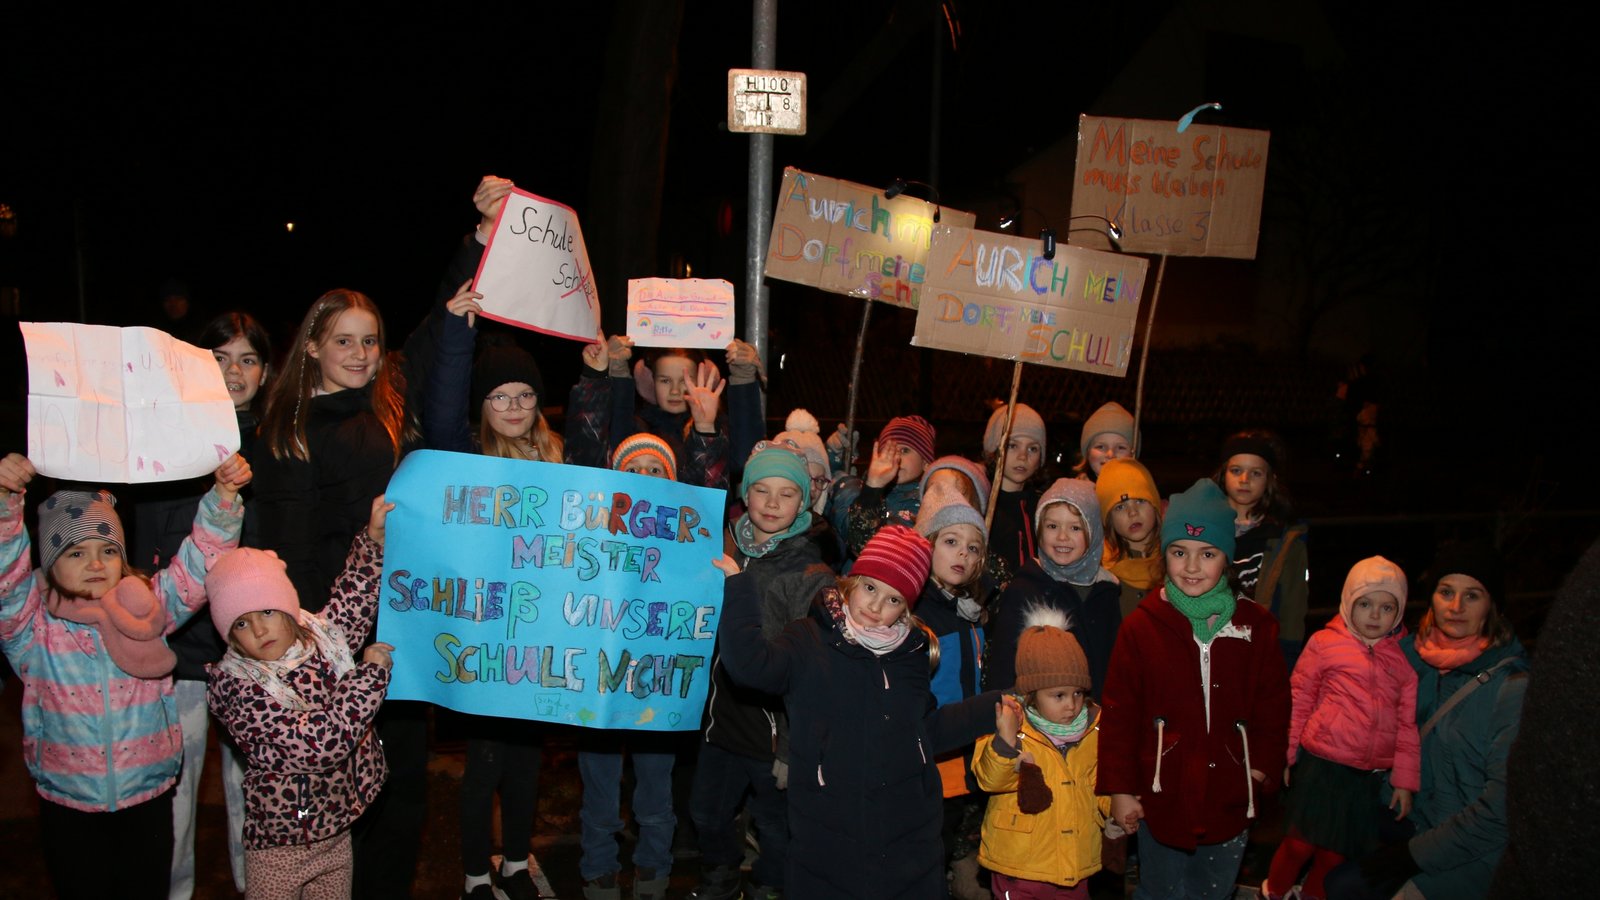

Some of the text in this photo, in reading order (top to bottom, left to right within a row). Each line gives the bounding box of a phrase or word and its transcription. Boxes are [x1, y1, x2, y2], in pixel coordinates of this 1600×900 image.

[783, 97, 791, 111] 8
[1089, 120, 1181, 168] Meine
[1083, 168, 1141, 195] muss
[510, 206, 574, 253] Schule
[1190, 210, 1211, 241] 3
[855, 250, 926, 284] meine
[1083, 269, 1139, 304] MEIN
[441, 484, 548, 529] HERR
[562, 591, 717, 641] UNSERE
[433, 632, 587, 692] SCHULE
